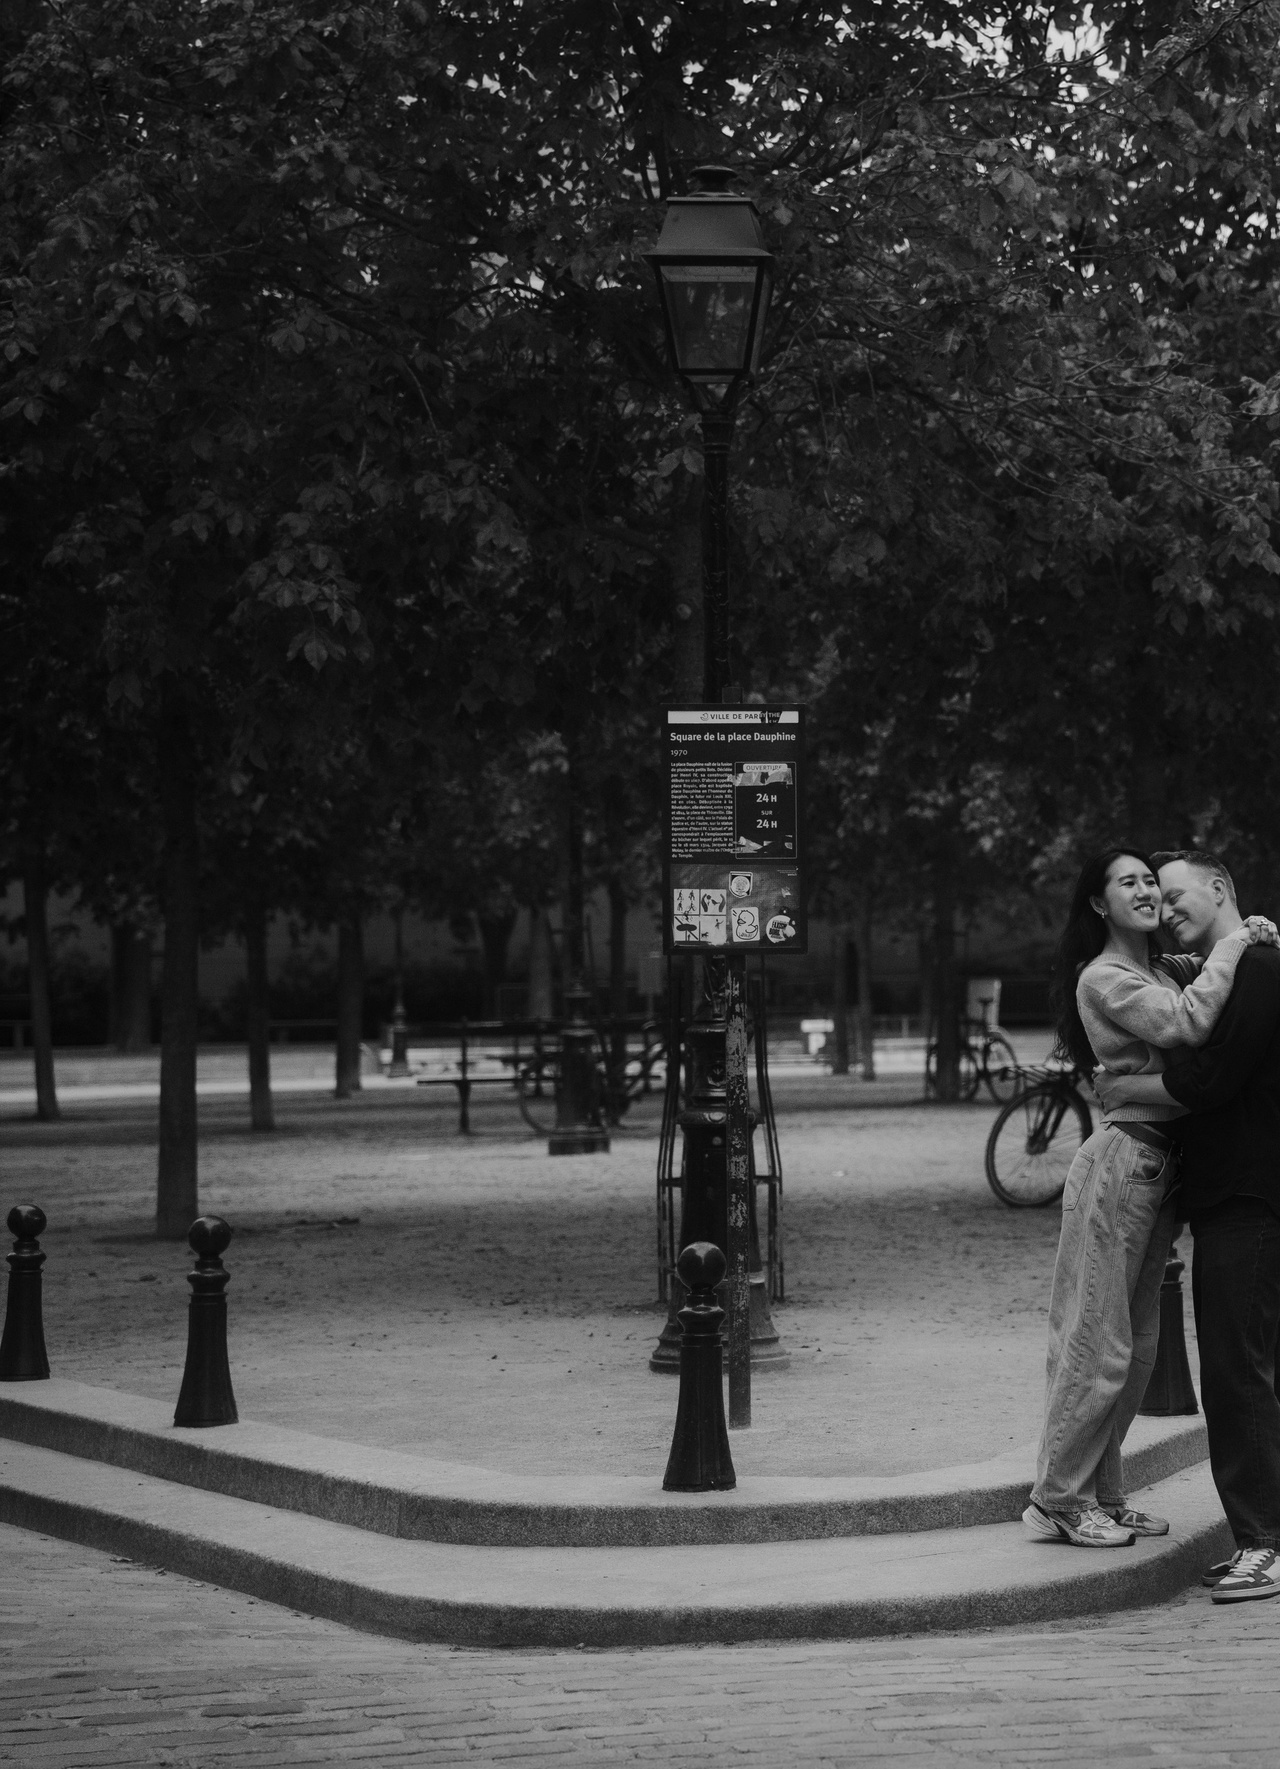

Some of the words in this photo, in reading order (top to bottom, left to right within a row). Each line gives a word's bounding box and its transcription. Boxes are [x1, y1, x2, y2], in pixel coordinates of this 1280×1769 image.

[670, 733, 702, 742] Square
[704, 732, 715, 741] de
[717, 732, 726, 741] la
[728, 732, 751, 742] place
[754, 732, 796, 742] Dauphine
[756, 794, 769, 802] 24
[756, 820, 769, 828] 24
